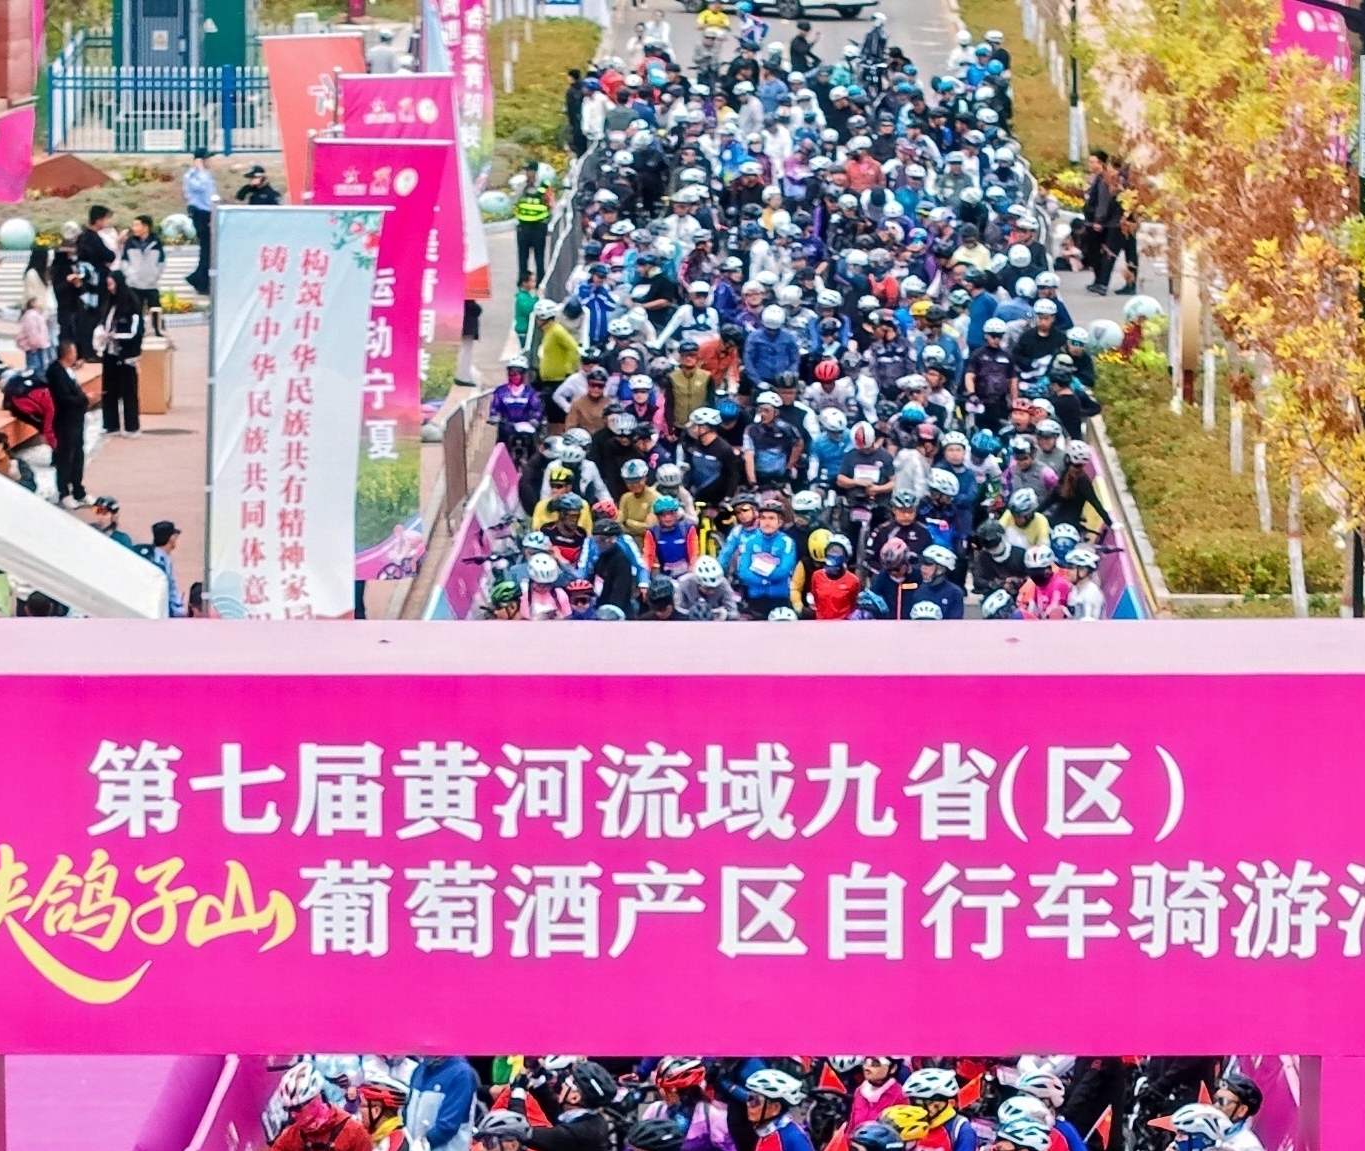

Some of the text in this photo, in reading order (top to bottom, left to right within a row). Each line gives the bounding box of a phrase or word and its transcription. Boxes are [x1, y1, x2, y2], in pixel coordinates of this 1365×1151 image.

[240, 245, 289, 618] 铸牢中华民族共同体意
[363, 267, 399, 461] 运动宁夏
[87, 740, 1185, 842] 第七届黄河流域九省(区)
